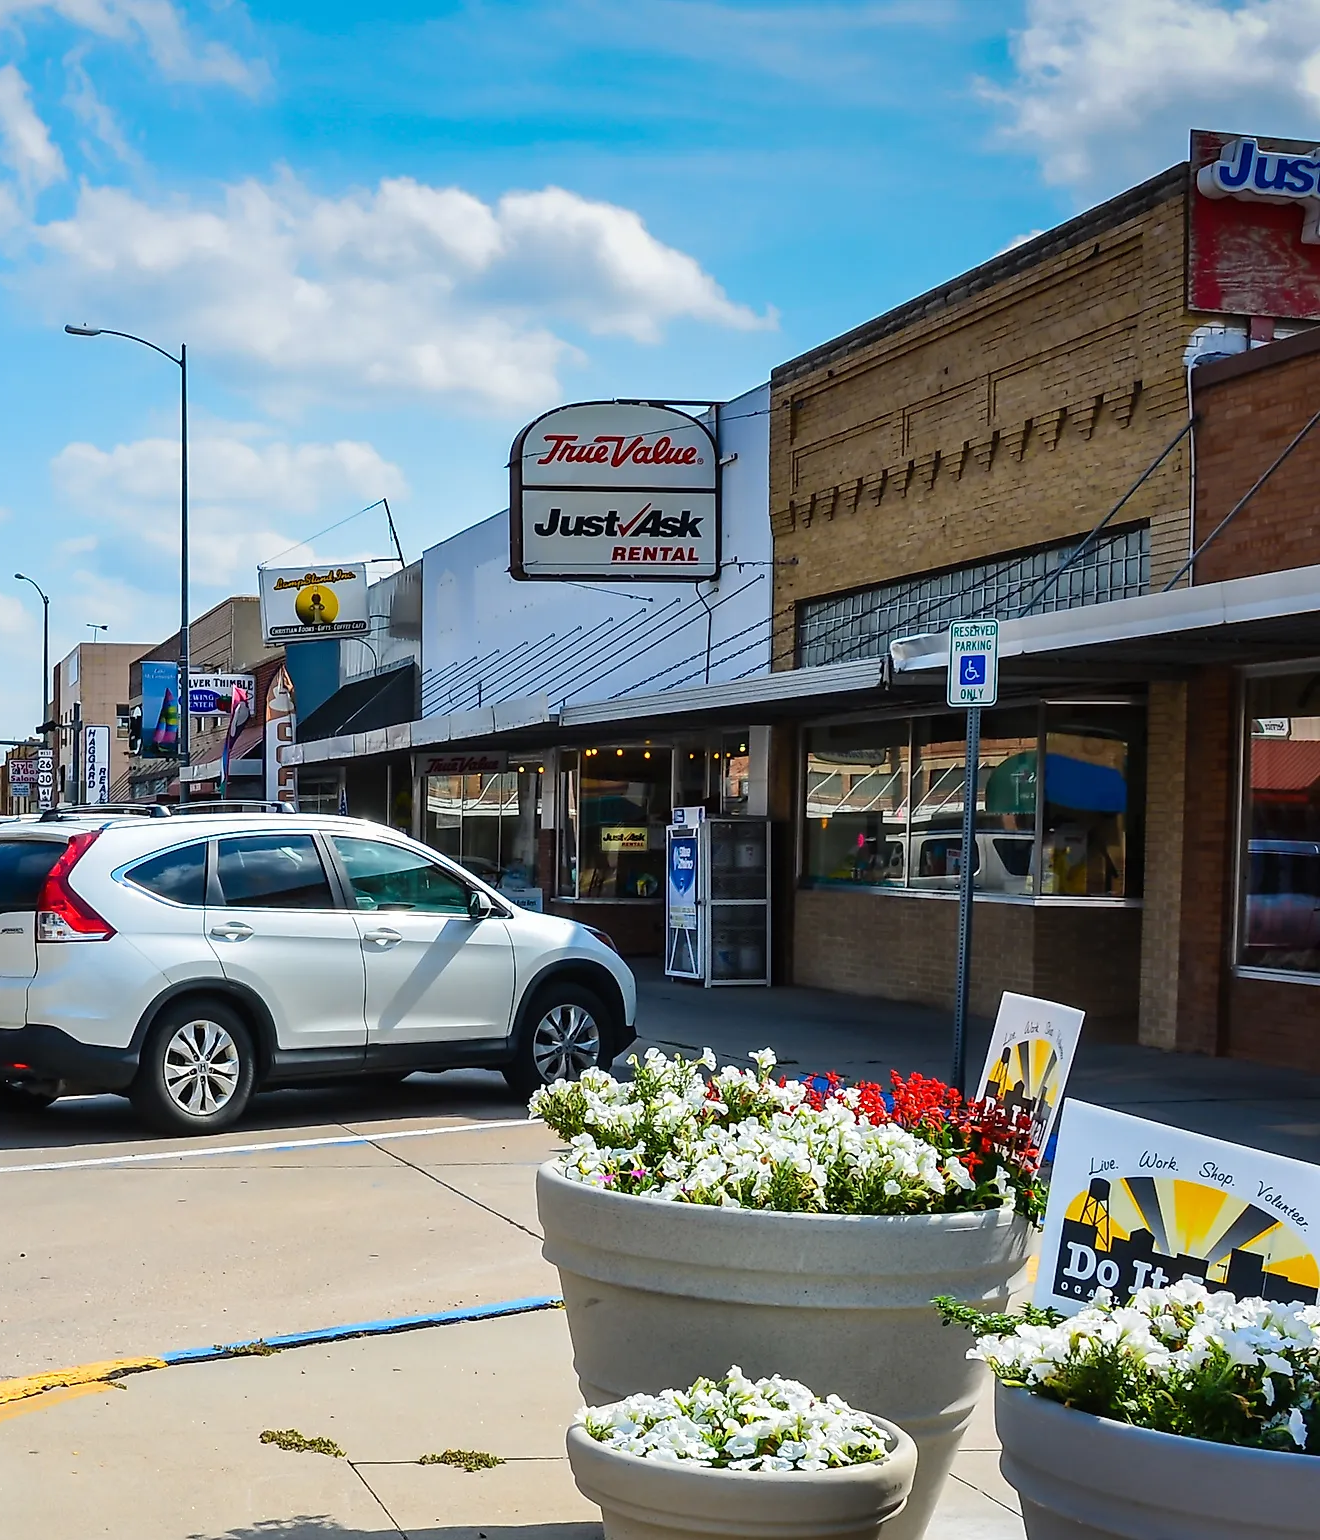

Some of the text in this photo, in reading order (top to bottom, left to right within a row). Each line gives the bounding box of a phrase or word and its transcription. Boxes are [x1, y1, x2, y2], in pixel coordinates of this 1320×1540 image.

[1220, 143, 1320, 192] Jus
[534, 508, 704, 538] Just Ask
[612, 547, 699, 561] RENTAL
[272, 626, 298, 635] CHRISTIAN
[954, 625, 996, 637] RESERVED
[955, 640, 992, 651] PARKING
[960, 688, 984, 700] ONLY
[40, 760, 51, 769] 26
[88, 729, 96, 789] HAGGARD
[40, 774, 51, 783] 30
[1089, 1150, 1308, 1232] Live. Work. Shop. Volunteer.
[1063, 1241, 1169, 1294] Do It
